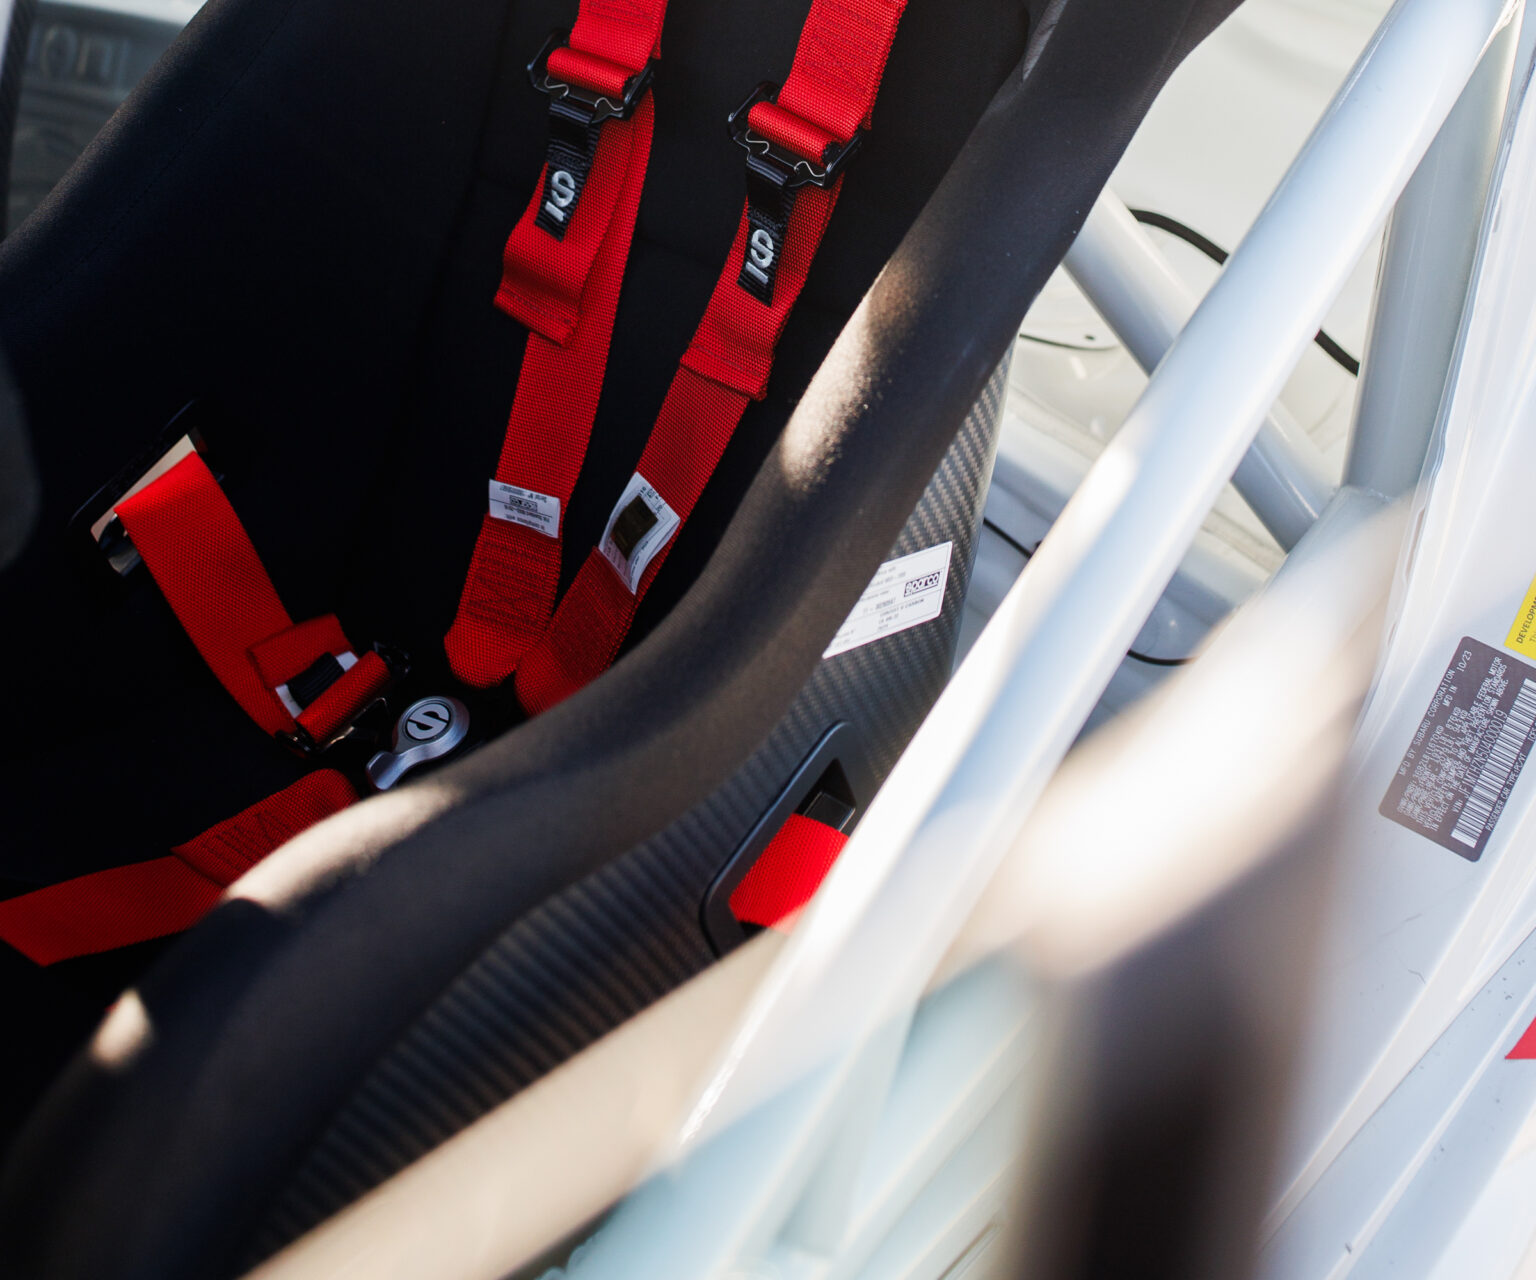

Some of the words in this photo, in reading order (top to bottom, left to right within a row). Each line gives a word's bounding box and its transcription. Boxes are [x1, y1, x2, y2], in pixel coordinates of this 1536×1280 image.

[904, 571, 941, 597] sparco
[1448, 684, 1458, 693] IN
[1455, 648, 1473, 672] 10/23
[1459, 700, 1480, 734] APPLICABLE
[1476, 675, 1492, 700] FEDERAL
[1487, 655, 1502, 675] MOTOR
[1470, 693, 1492, 729] PREVENTION
[1487, 662, 1507, 694] STANDARDS
[1406, 747, 1417, 759] BY
[1412, 717, 1431, 746] SUBARU
[1426, 667, 1456, 718] CORPORATION
[1455, 762, 1468, 779] DATE
[1466, 715, 1491, 754] MANUFACTURE
[1499, 785, 1511, 800] CAR
